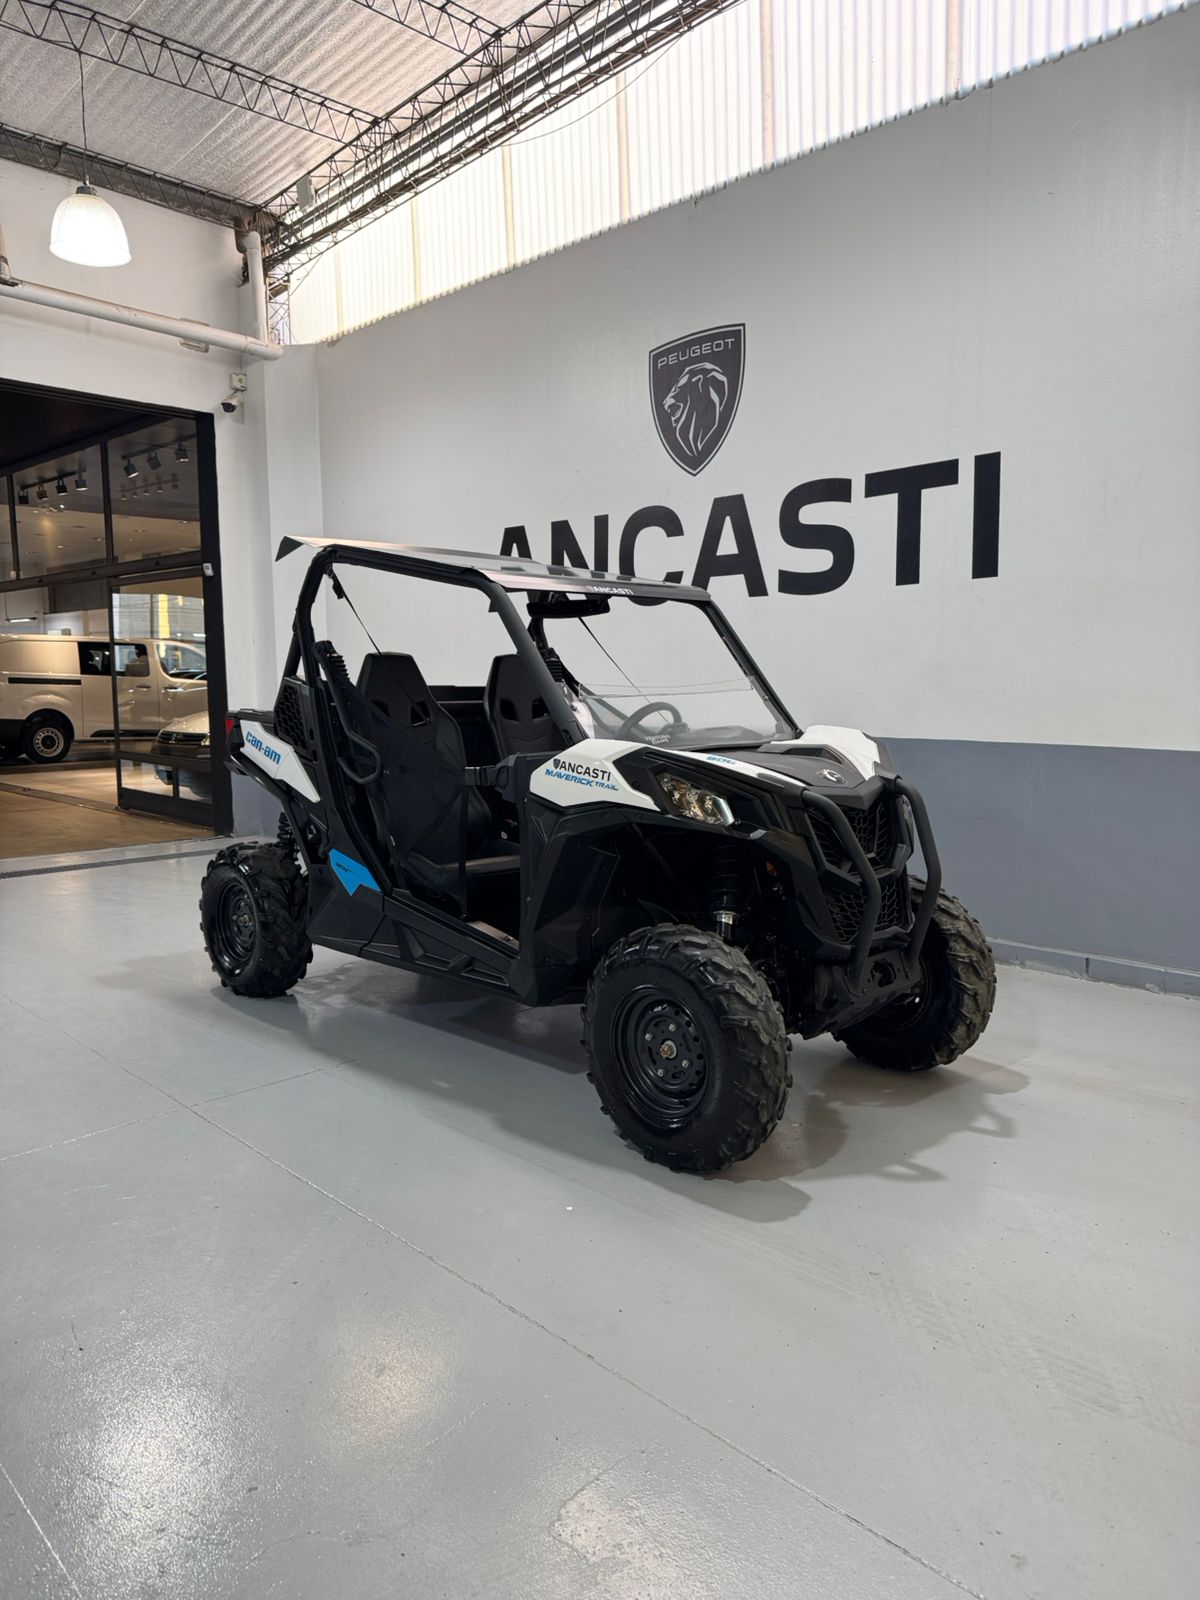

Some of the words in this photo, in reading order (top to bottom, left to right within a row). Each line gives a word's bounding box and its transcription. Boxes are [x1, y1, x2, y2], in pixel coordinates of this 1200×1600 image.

[657, 338, 735, 370] PEUGEOT
[593, 585, 635, 596] ANCASTI
[245, 731, 282, 766] can-am
[545, 768, 595, 787] MAVERICK
[594, 781, 619, 792] TRAIL
[559, 760, 611, 782] ANCASTI
